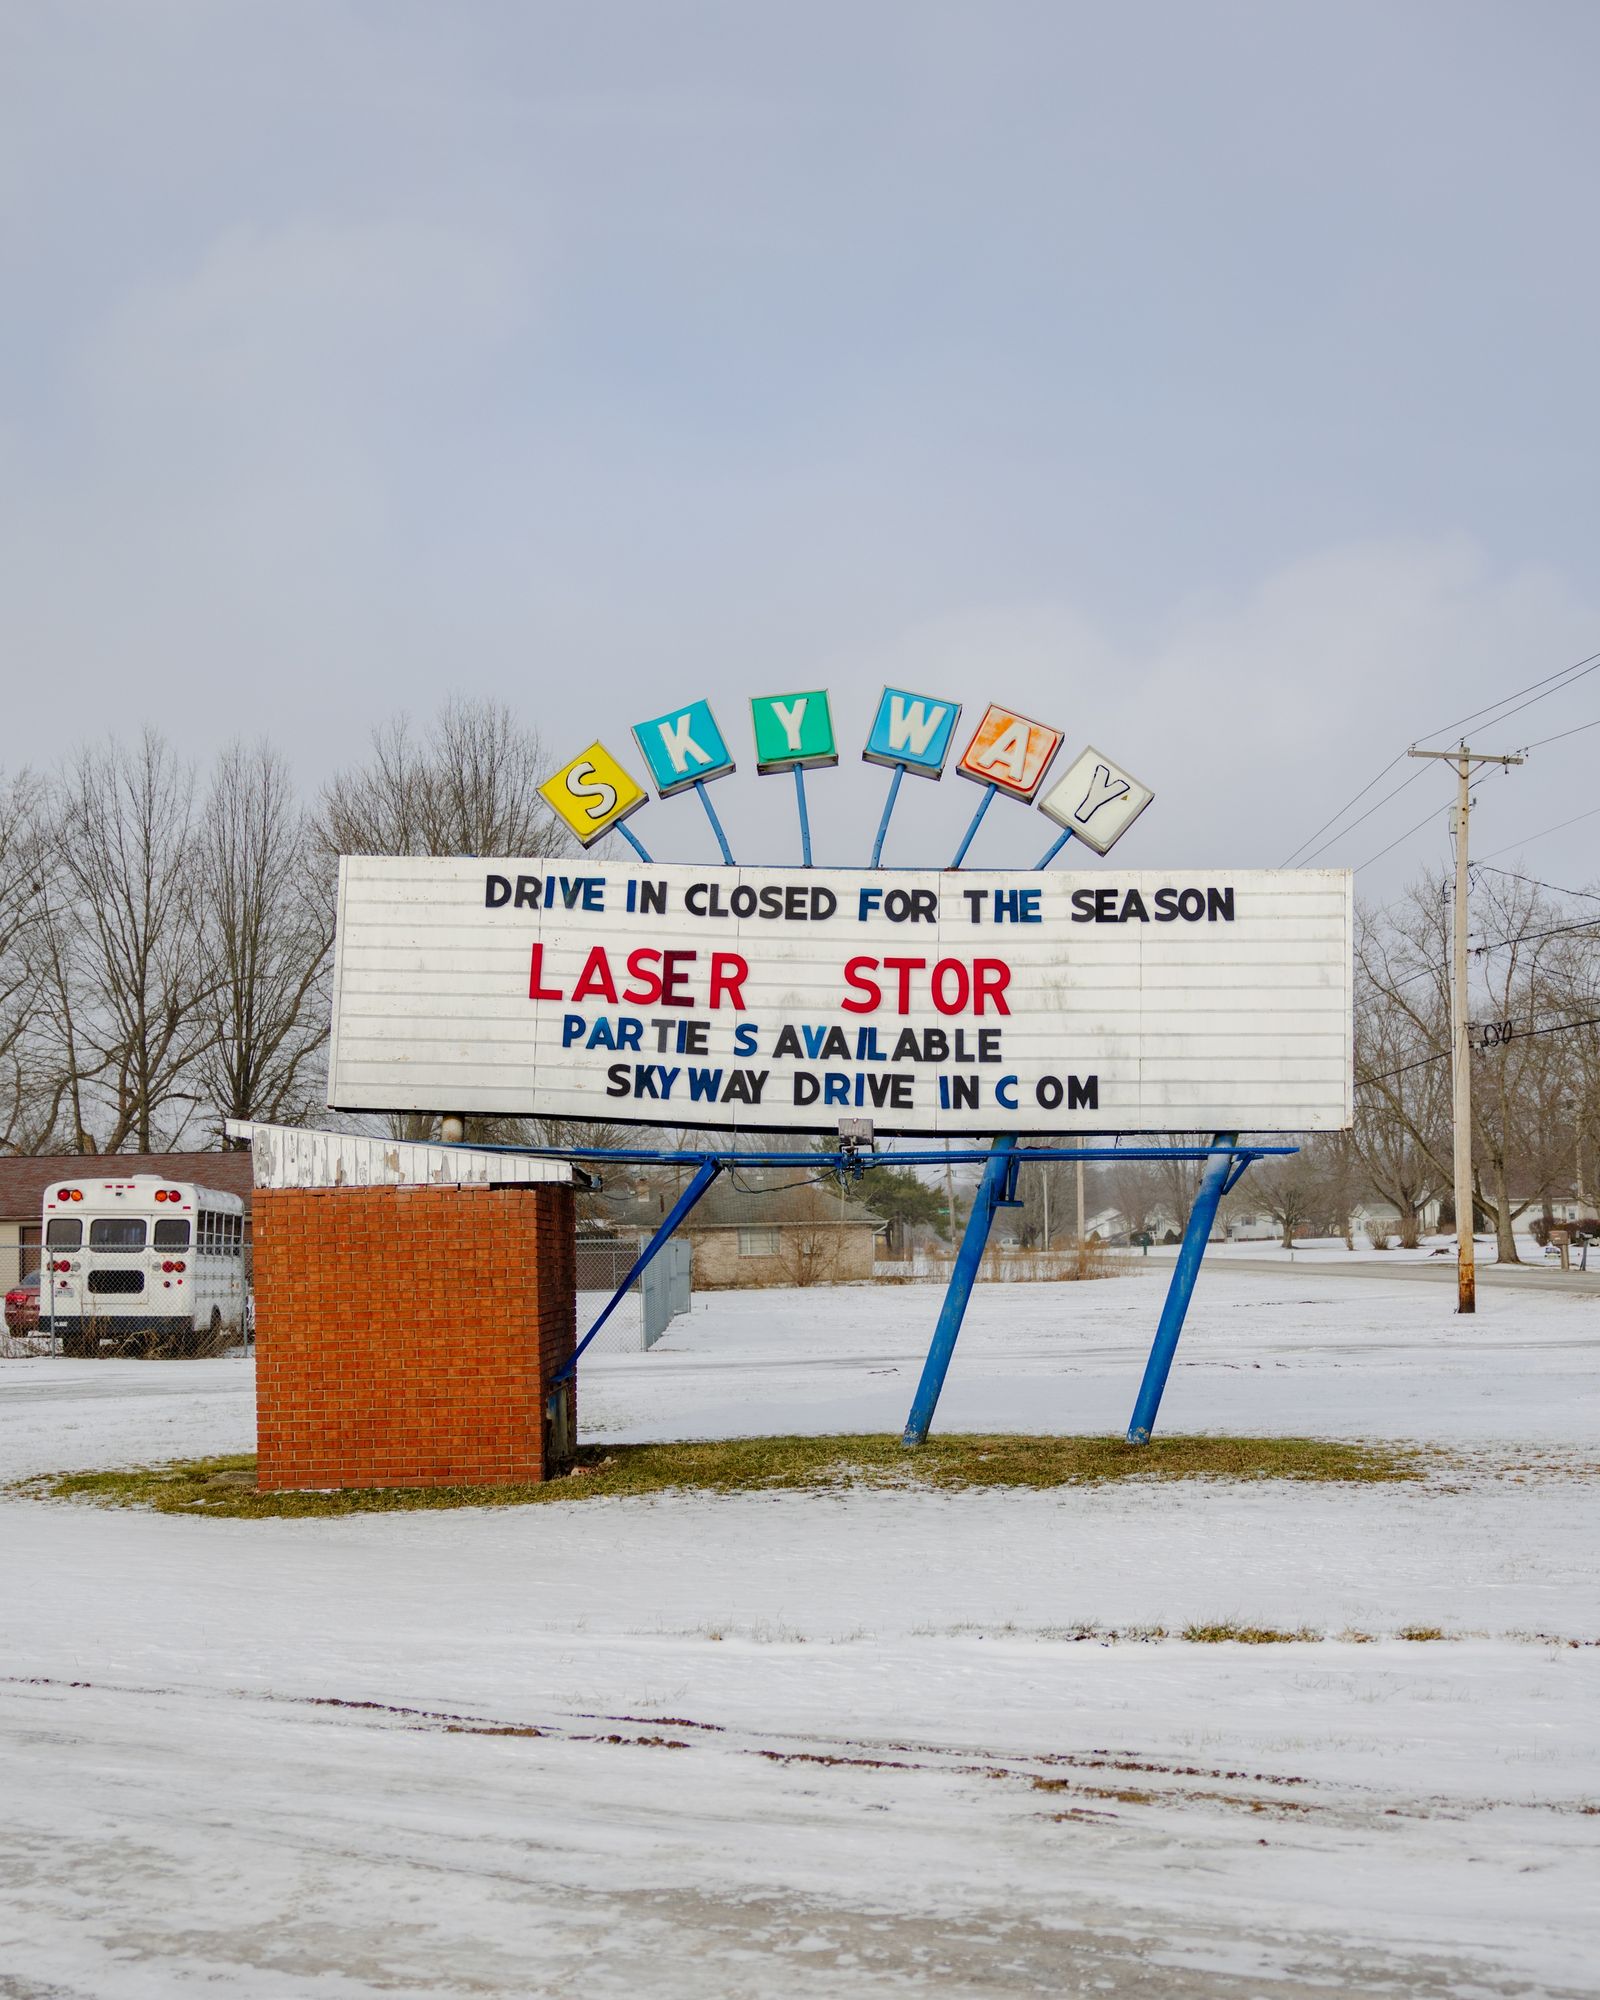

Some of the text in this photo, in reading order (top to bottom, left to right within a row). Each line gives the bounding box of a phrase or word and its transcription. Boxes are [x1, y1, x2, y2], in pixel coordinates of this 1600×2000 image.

[565, 696, 1131, 824] SKYWAY
[486, 875, 1234, 923] DRIVE IN CLOSED FOR THE SEASON
[529, 943, 1011, 1015] LASER STOR
[772, 1025, 1001, 1062] AVAILABLE
[607, 1064, 769, 1104] SKYWAY
[794, 1072, 914, 1109] DRIVE
[939, 1076, 979, 1109] IN
